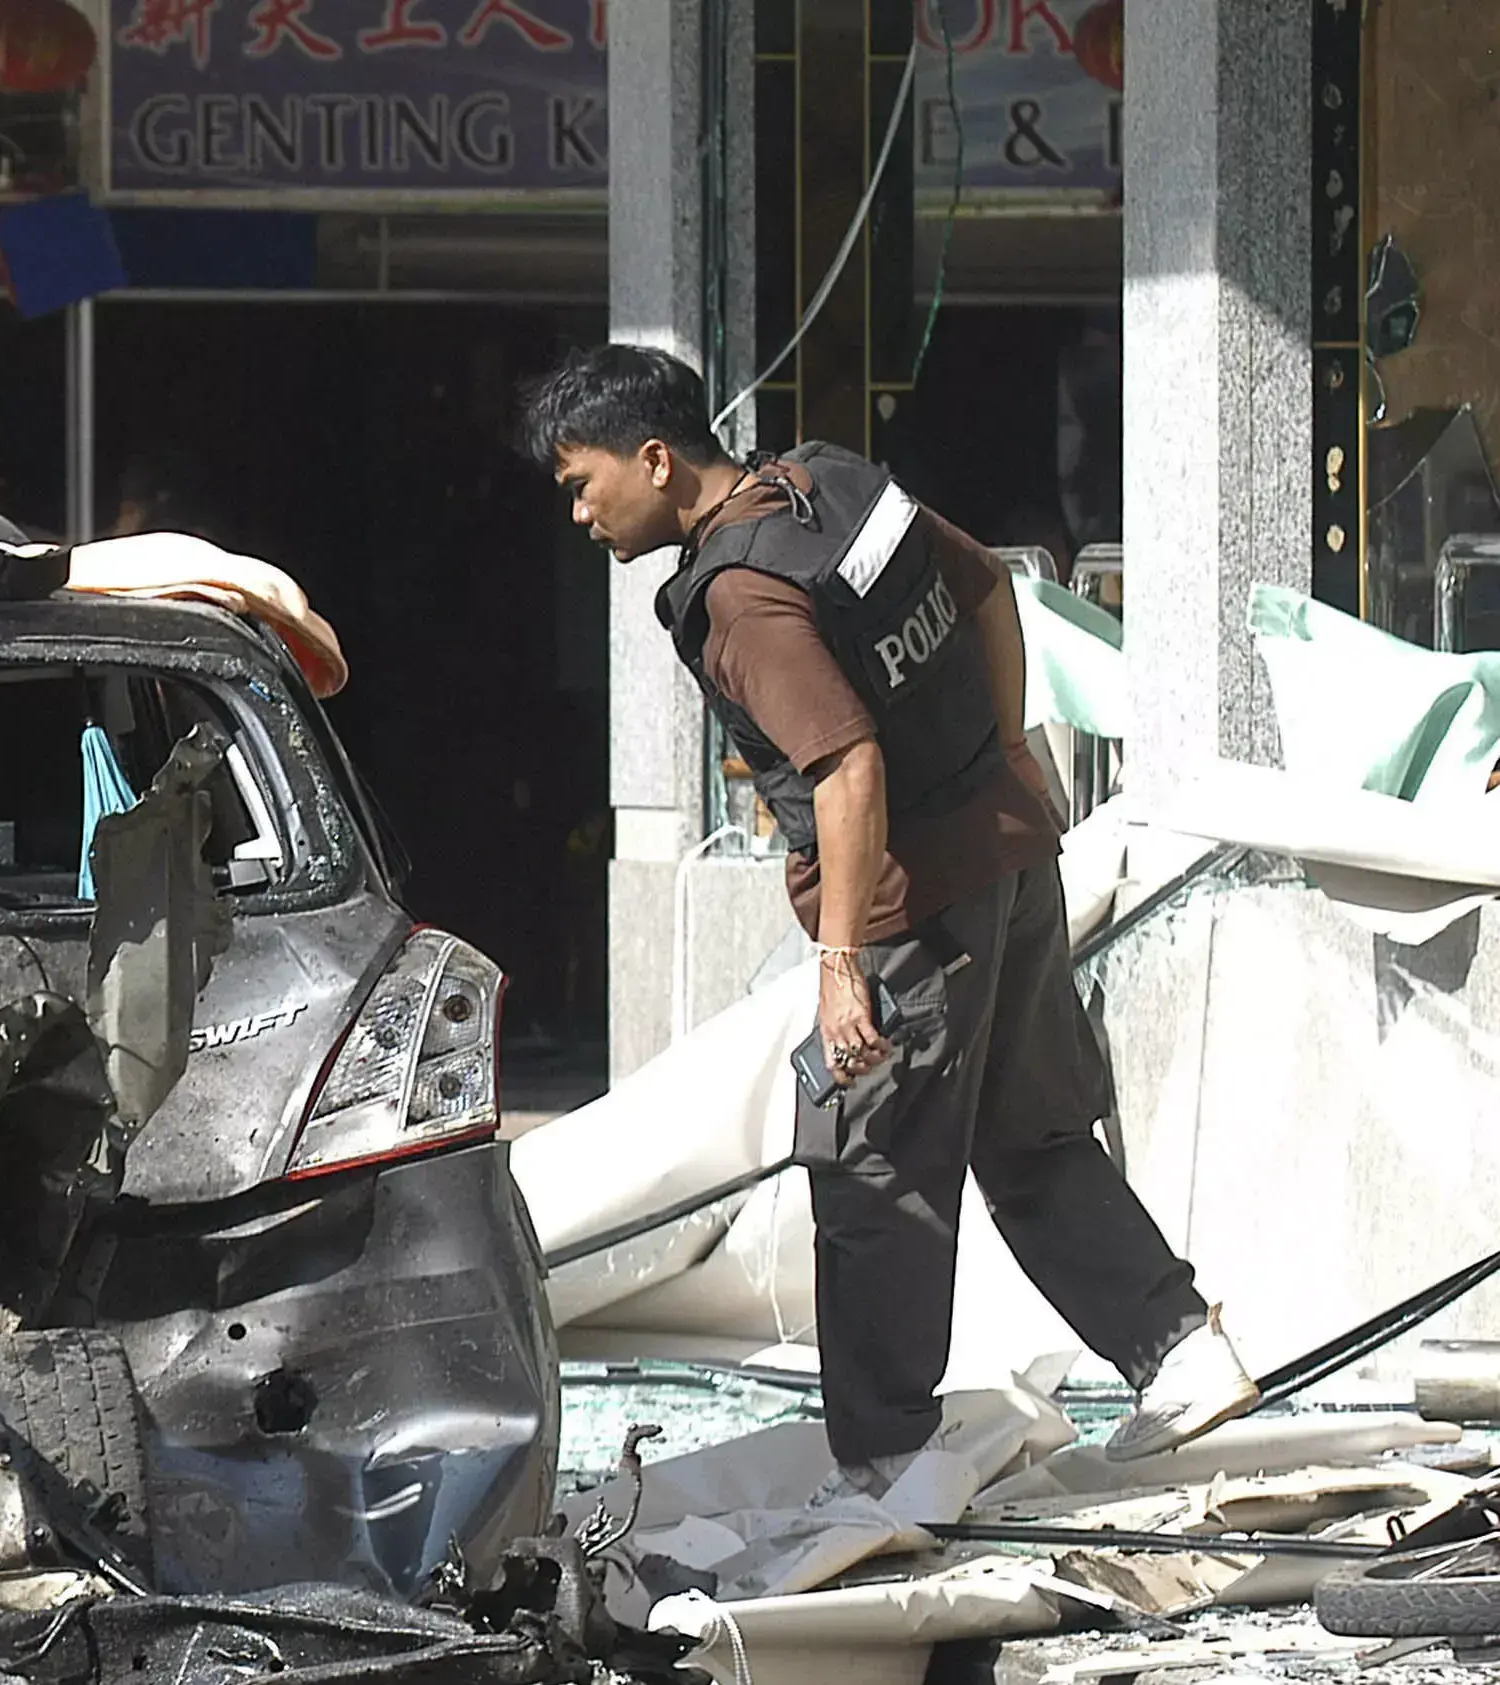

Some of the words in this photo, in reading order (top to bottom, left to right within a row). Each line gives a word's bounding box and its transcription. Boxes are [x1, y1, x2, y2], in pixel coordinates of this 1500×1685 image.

[136, 98, 509, 169] GENTING
[874, 569, 958, 689] POLIC
[189, 1001, 309, 1053] SWIFT
